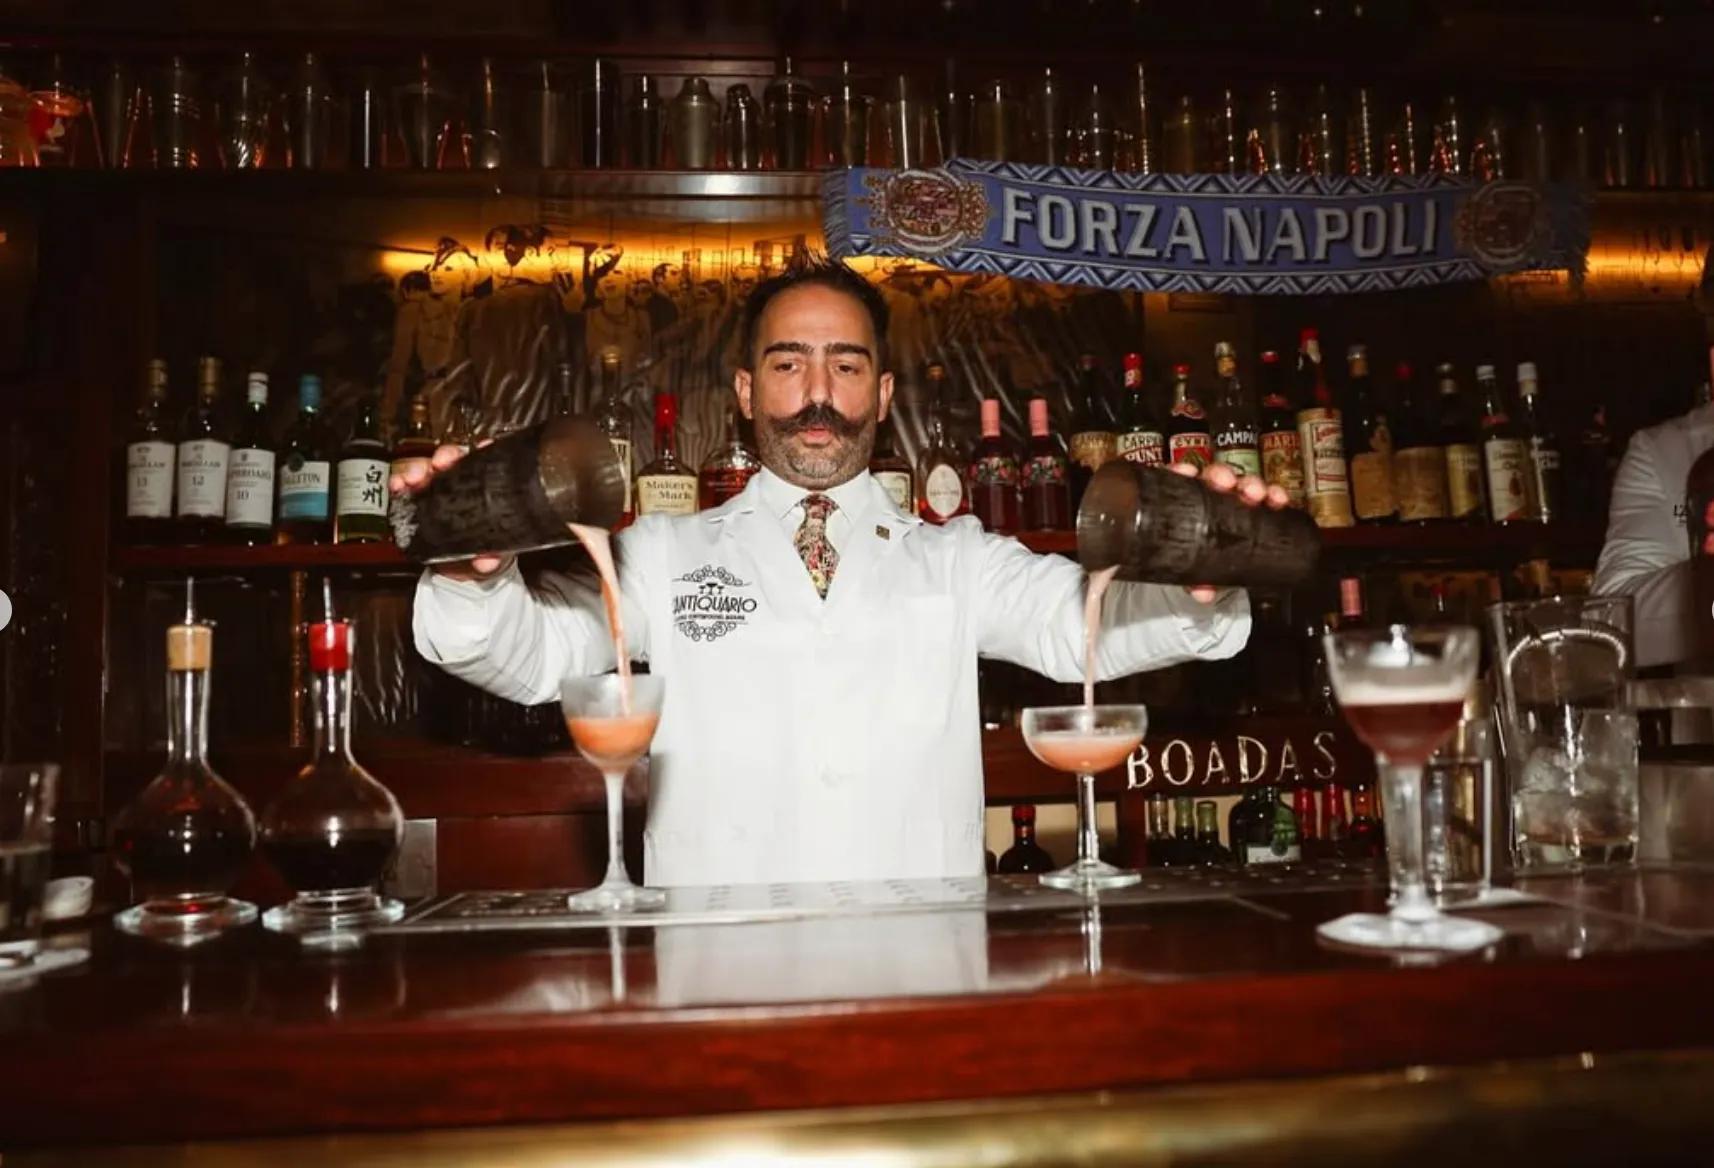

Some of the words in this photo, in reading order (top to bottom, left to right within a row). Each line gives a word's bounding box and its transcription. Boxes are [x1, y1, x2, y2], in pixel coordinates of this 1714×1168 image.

[1002, 186, 1207, 261] FORZA
[1223, 199, 1437, 262] NAPOLI
[362, 464, 383, 507] 白州
[659, 491, 693, 500] Mark
[1127, 731, 1337, 790] BOADAS
